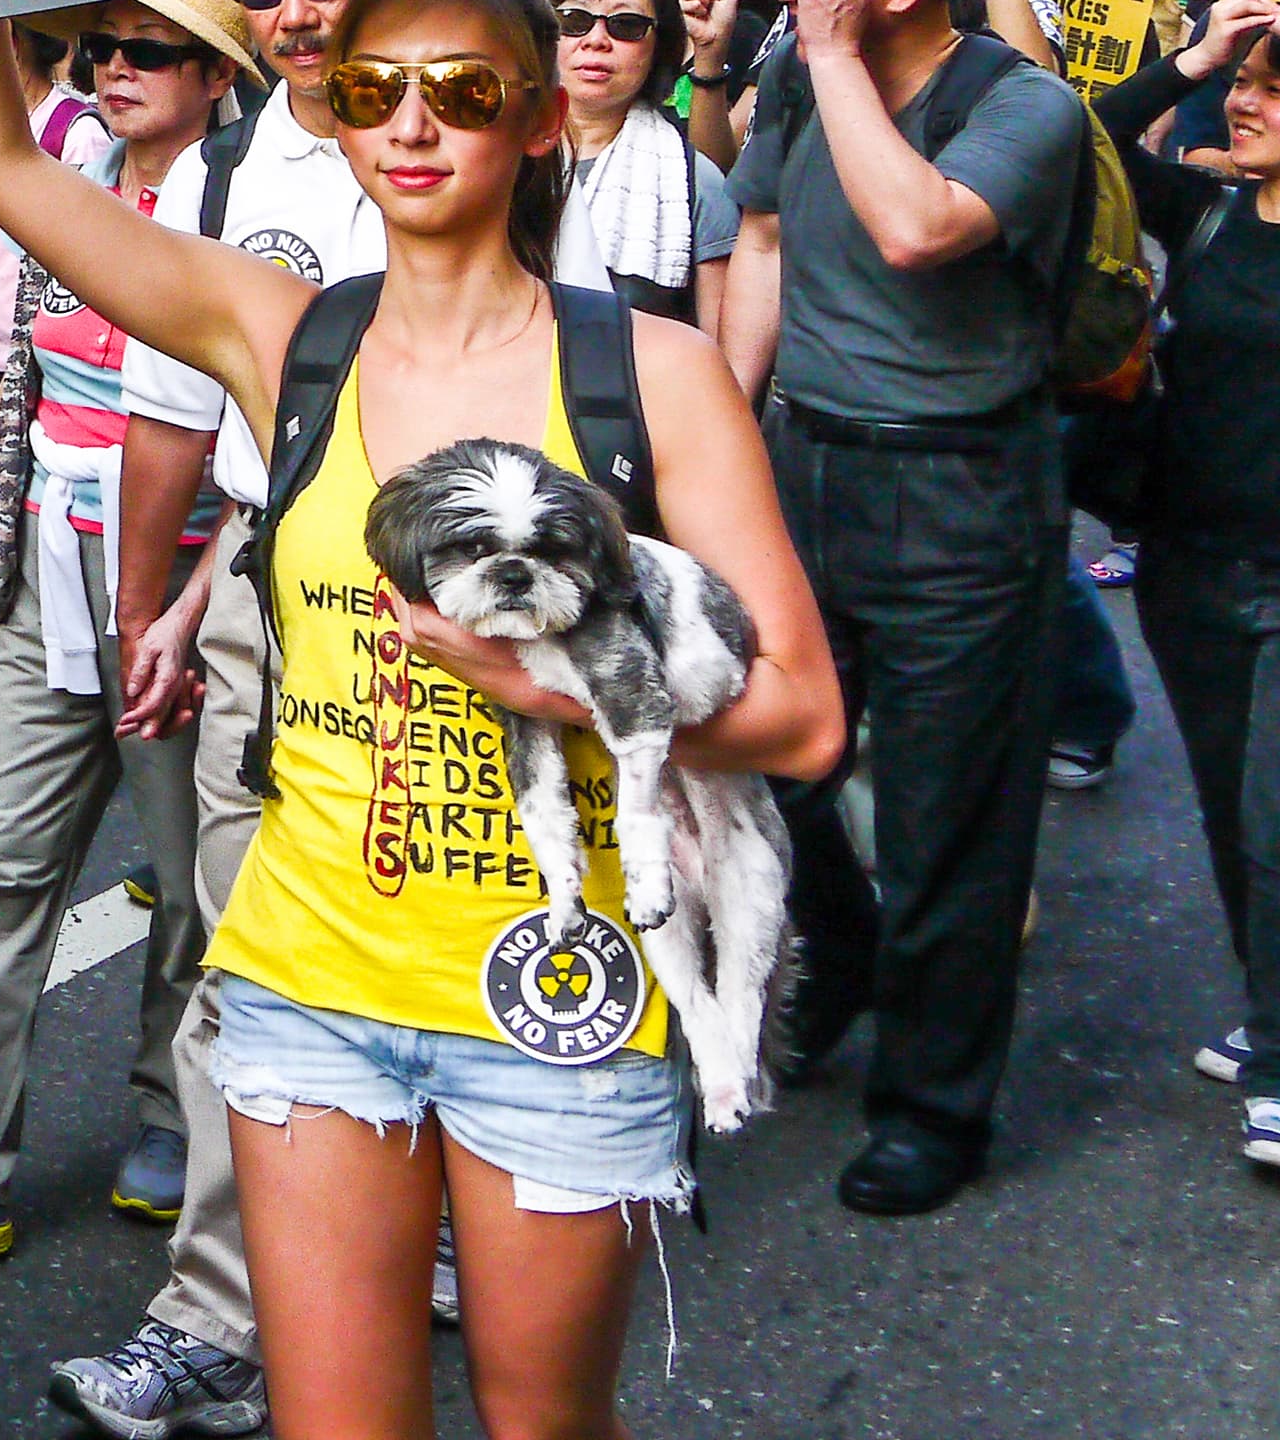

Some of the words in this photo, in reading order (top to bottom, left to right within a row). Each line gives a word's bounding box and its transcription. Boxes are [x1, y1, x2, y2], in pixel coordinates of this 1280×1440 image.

[243, 232, 271, 252] NO
[276, 232, 322, 282] NUKE
[50, 290, 79, 311] FEA
[277, 691, 508, 761] ONSEQUENC
[374, 832, 549, 900] SUFFE
[496, 926, 539, 970] NO
[504, 1001, 548, 1046] NO
[556, 997, 629, 1056] FEAR
